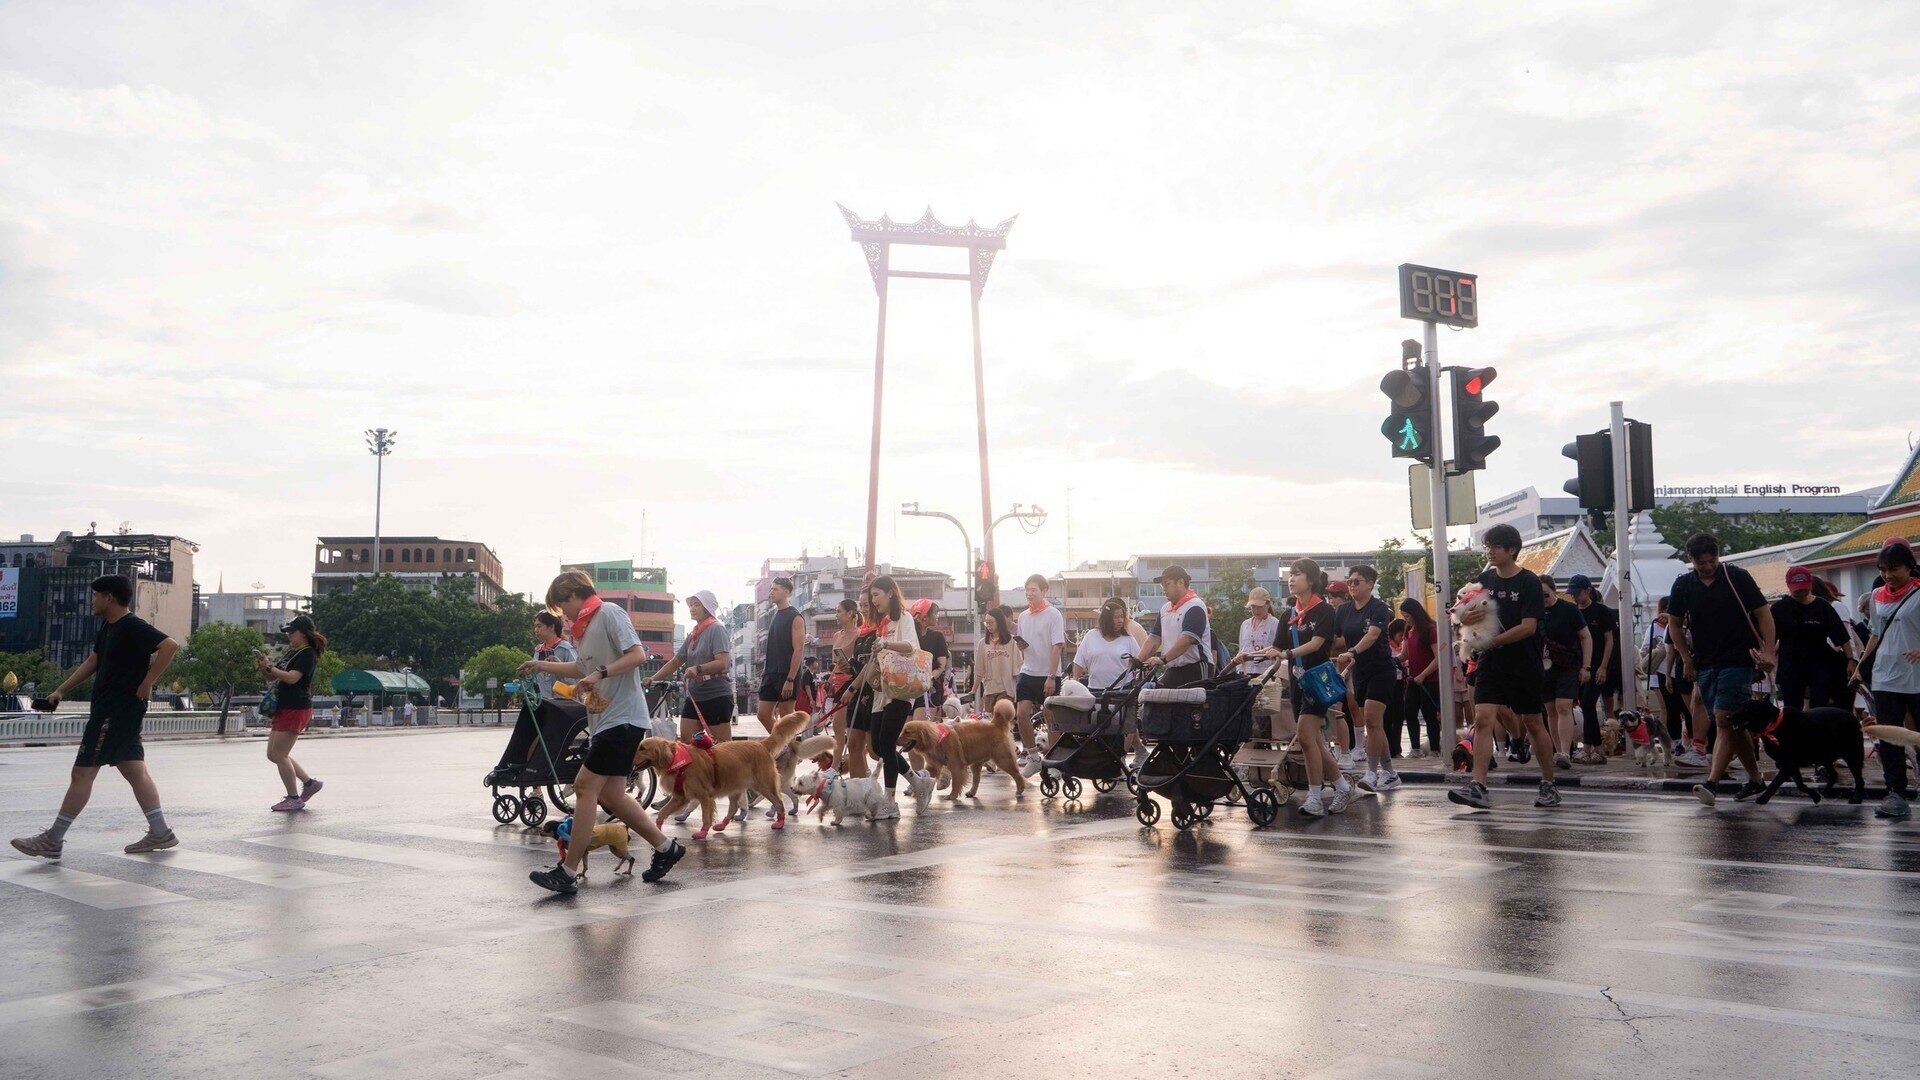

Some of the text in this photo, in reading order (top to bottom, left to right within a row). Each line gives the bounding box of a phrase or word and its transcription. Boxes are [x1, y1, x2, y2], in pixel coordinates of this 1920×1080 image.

[1654, 484, 1840, 496] njamarachalai English Program
[1624, 571, 1631, 581] 4
